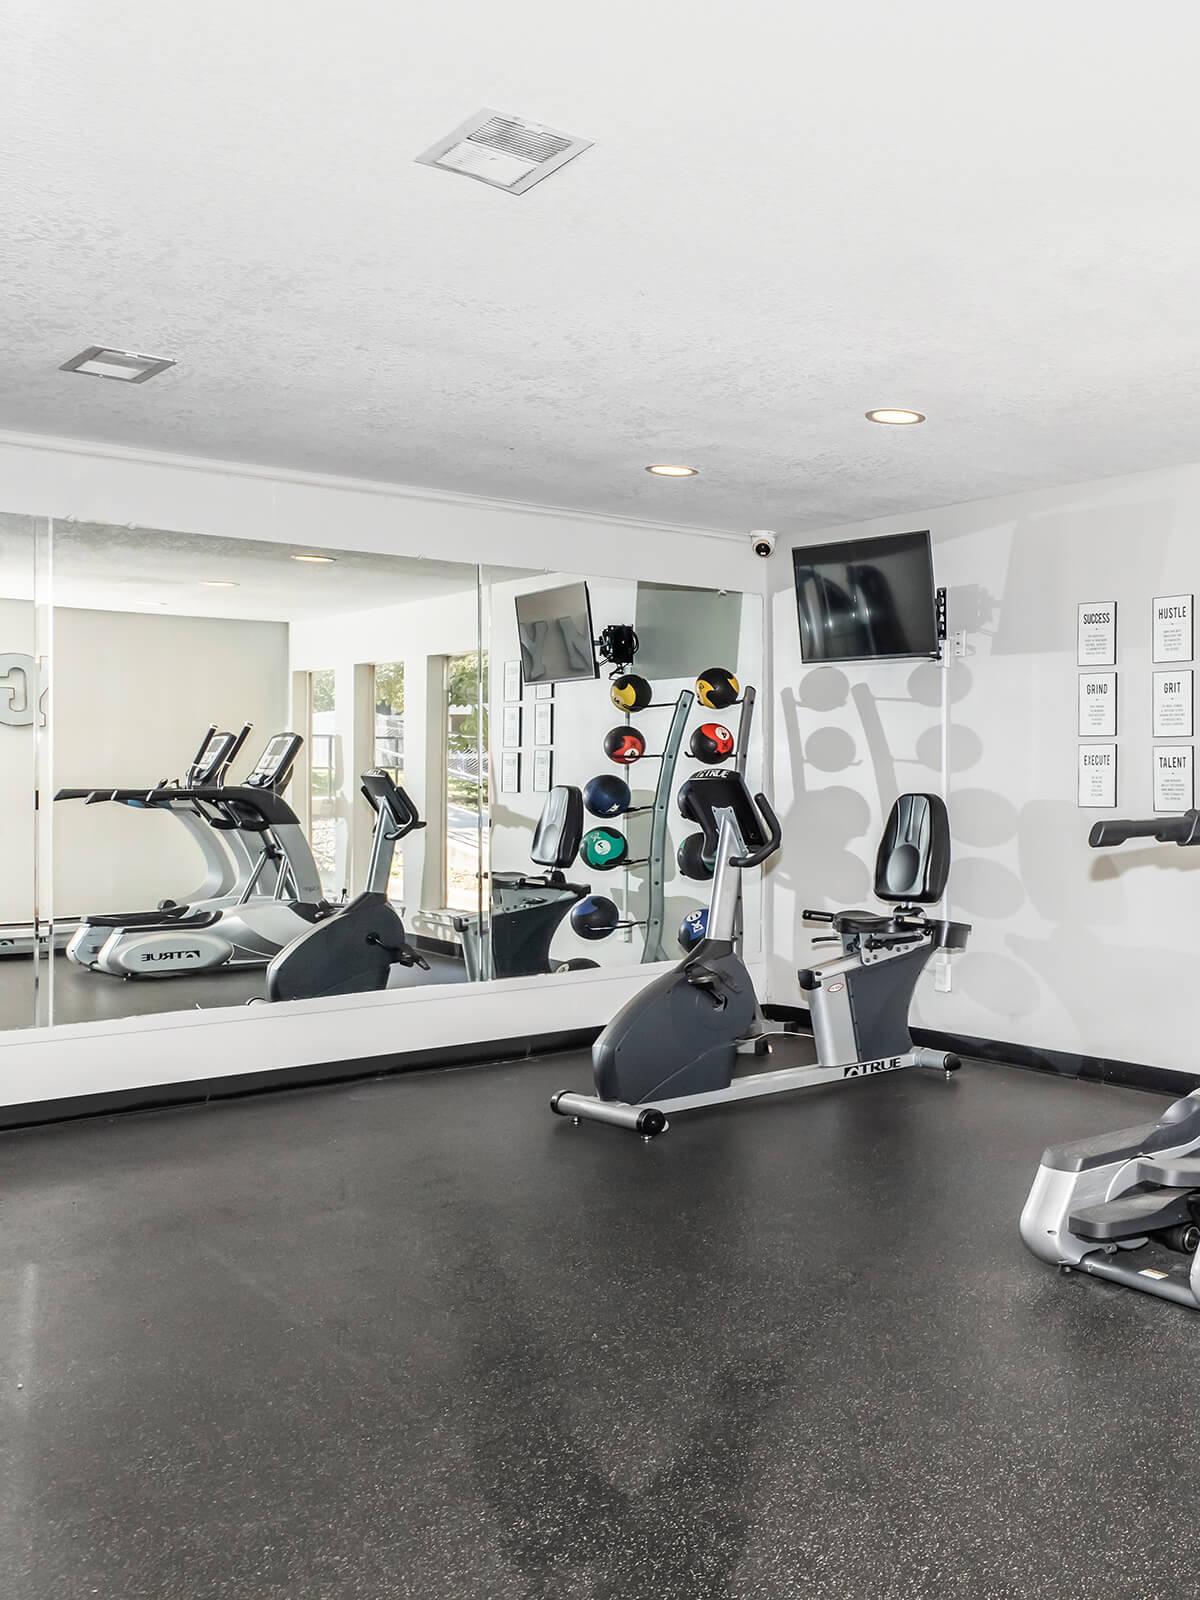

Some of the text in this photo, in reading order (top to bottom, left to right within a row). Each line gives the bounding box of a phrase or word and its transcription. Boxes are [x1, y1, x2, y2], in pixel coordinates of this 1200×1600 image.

[1083, 612, 1111, 625] SUCCESS
[1158, 606, 1187, 620] HUSTLE
[1086, 683, 1109, 695] GRIND
[1163, 682, 1182, 694] GRIT
[1083, 754, 1111, 766] EXECUTE
[1158, 756, 1187, 768] TALENT
[704, 769, 729, 778] TRUE
[860, 1057, 901, 1075] TRUE
